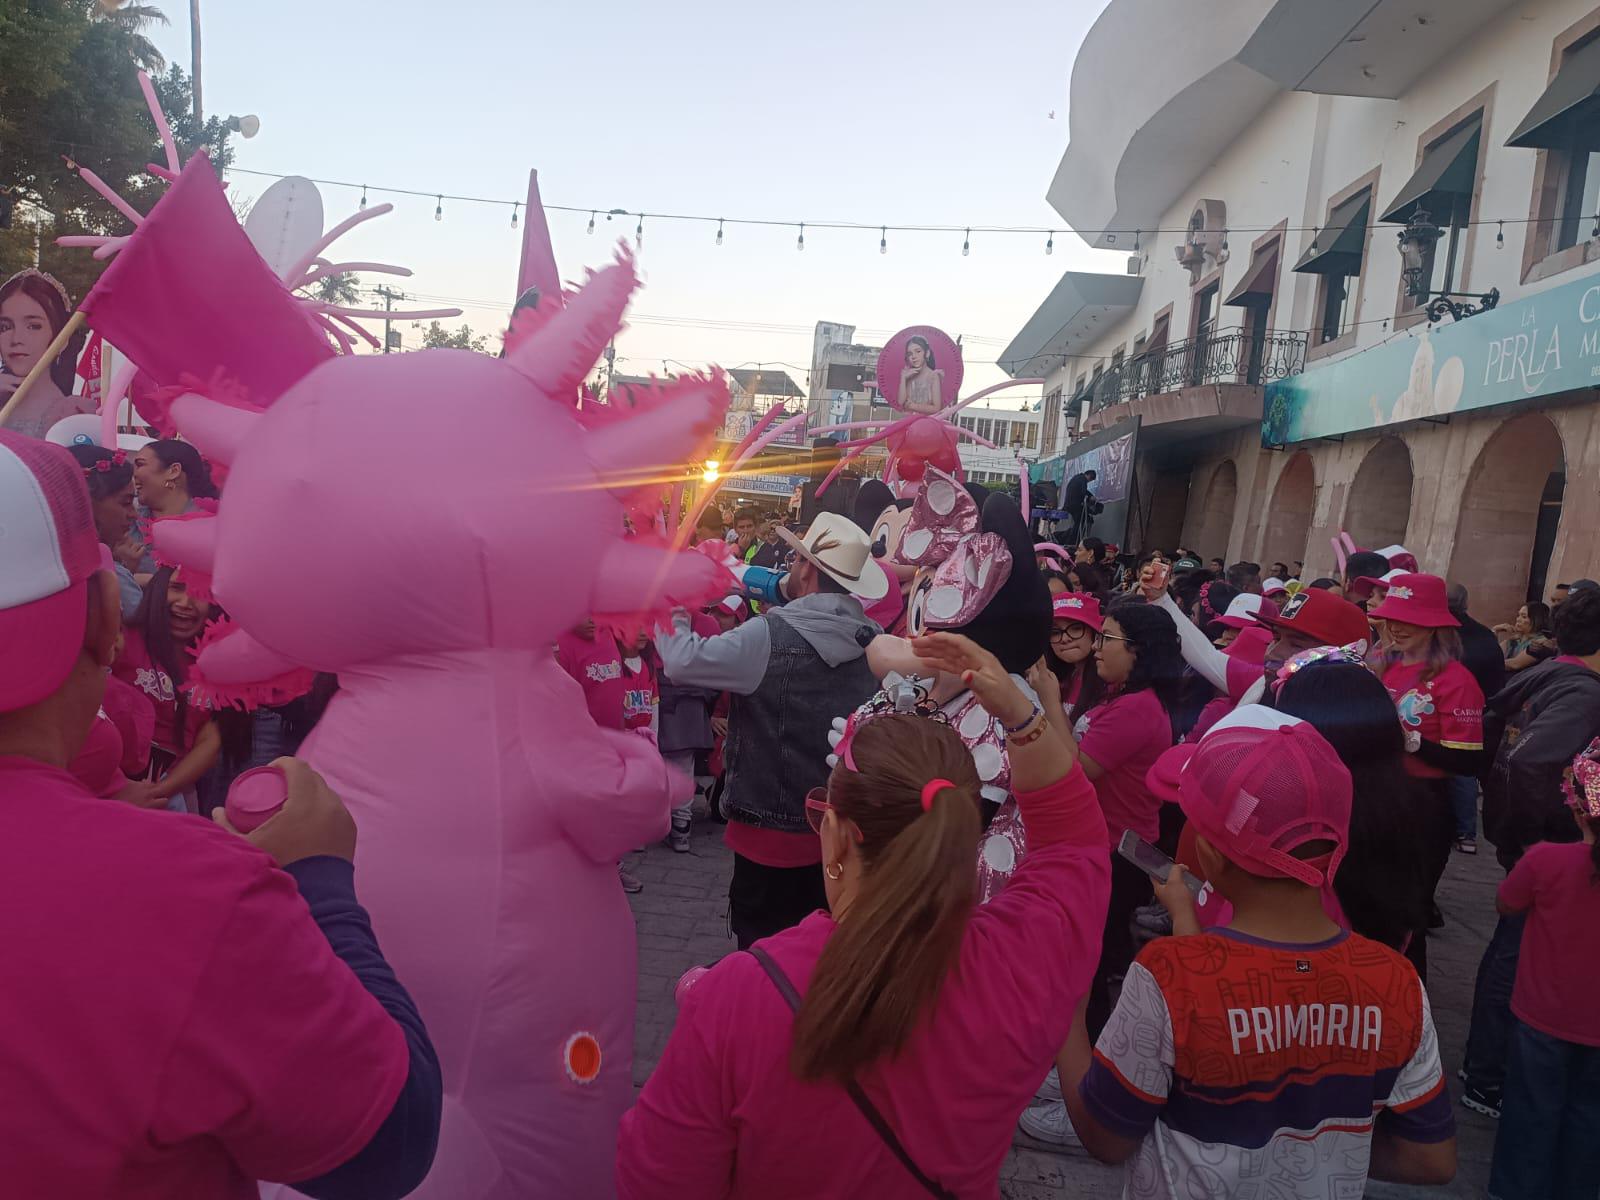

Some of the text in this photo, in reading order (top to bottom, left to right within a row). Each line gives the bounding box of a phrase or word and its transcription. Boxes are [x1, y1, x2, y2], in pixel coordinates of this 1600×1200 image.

[1521, 305, 1535, 328] LA
[1579, 285, 1600, 324] C
[1482, 323, 1562, 394] PERLA
[1228, 1003, 1382, 1055] PRIMARIA
